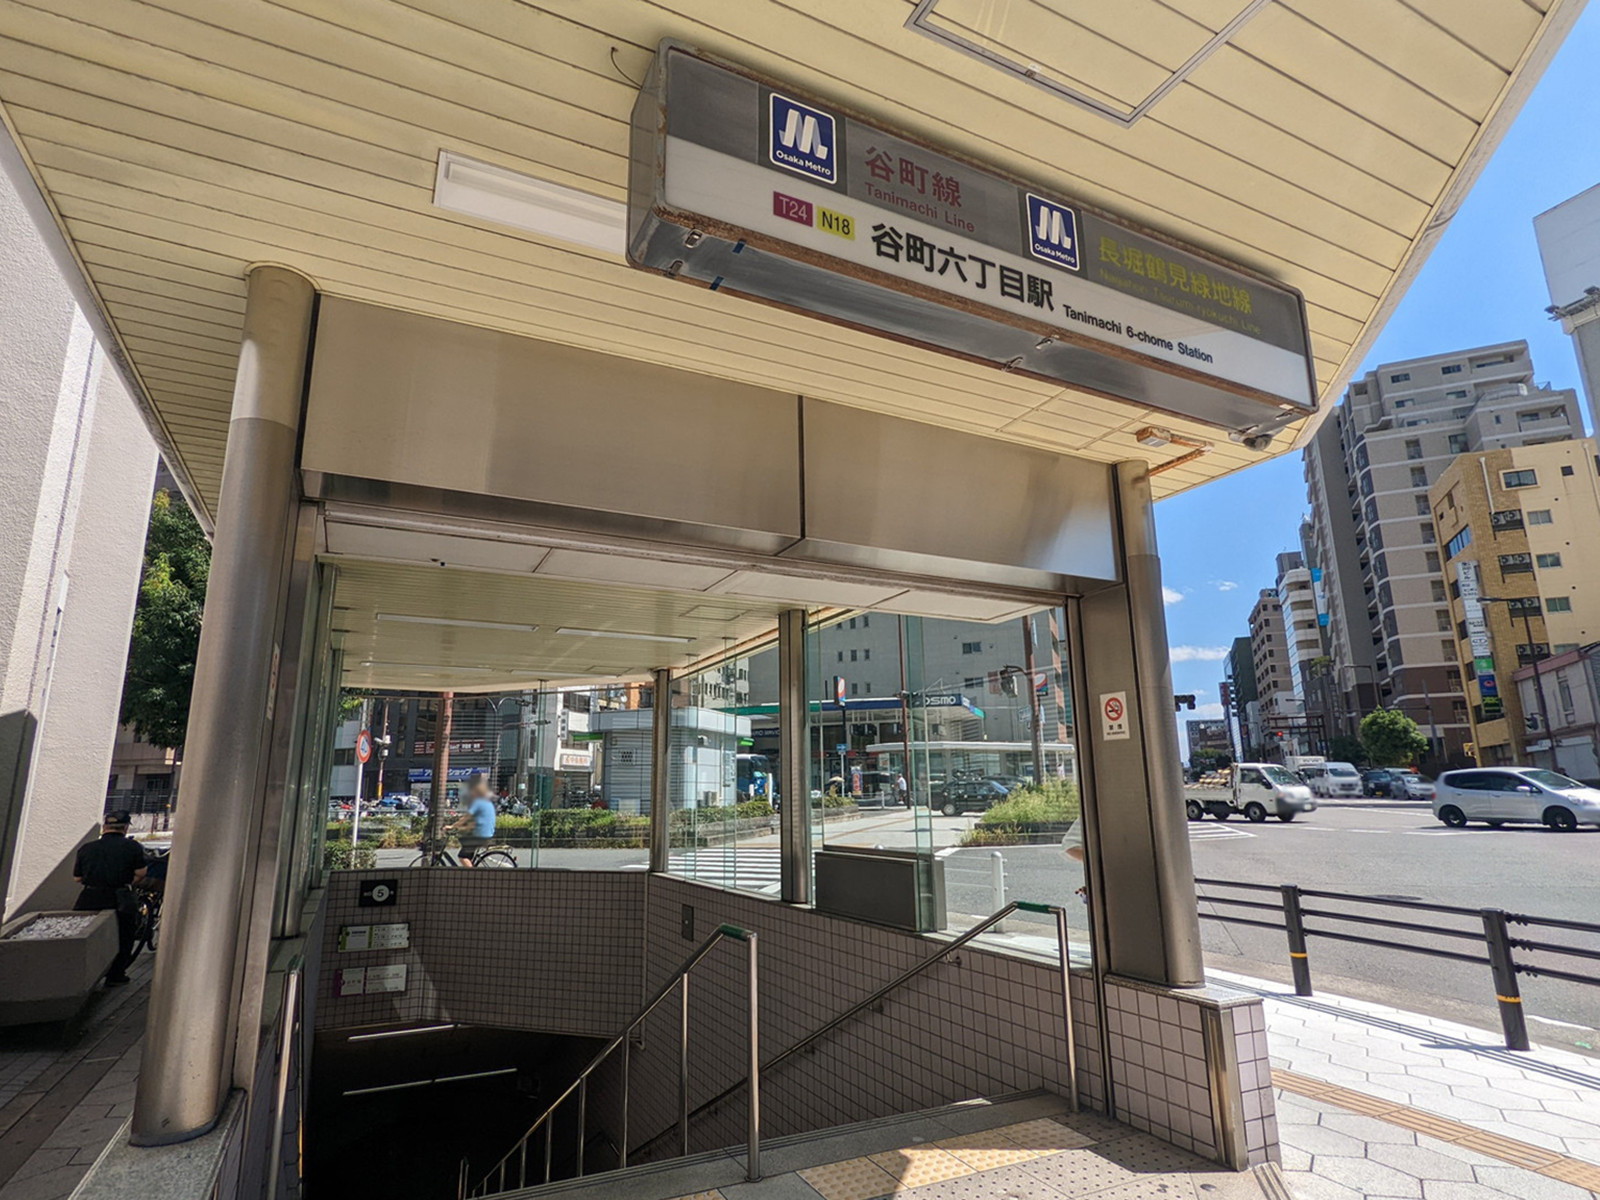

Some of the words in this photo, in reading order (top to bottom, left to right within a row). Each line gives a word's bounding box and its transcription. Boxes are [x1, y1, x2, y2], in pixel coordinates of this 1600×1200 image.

[776, 150, 804, 166] Osaka
[804, 160, 831, 176] Metro
[865, 147, 962, 208] 谷町線
[779, 196, 808, 221] T24
[821, 211, 851, 235] N18
[865, 182, 938, 219] Tanimachi
[945, 211, 975, 232] Line
[871, 223, 1055, 312] 谷町六丁目駅
[1034, 243, 1056, 257] Osaka
[1055, 250, 1076, 264] Metro
[1100, 236, 1253, 315] 長堀鶴見緑地線
[1063, 304, 1122, 335] Tanimachi
[1126, 325, 1174, 351] 6-chome
[1177, 341, 1214, 363] Station
